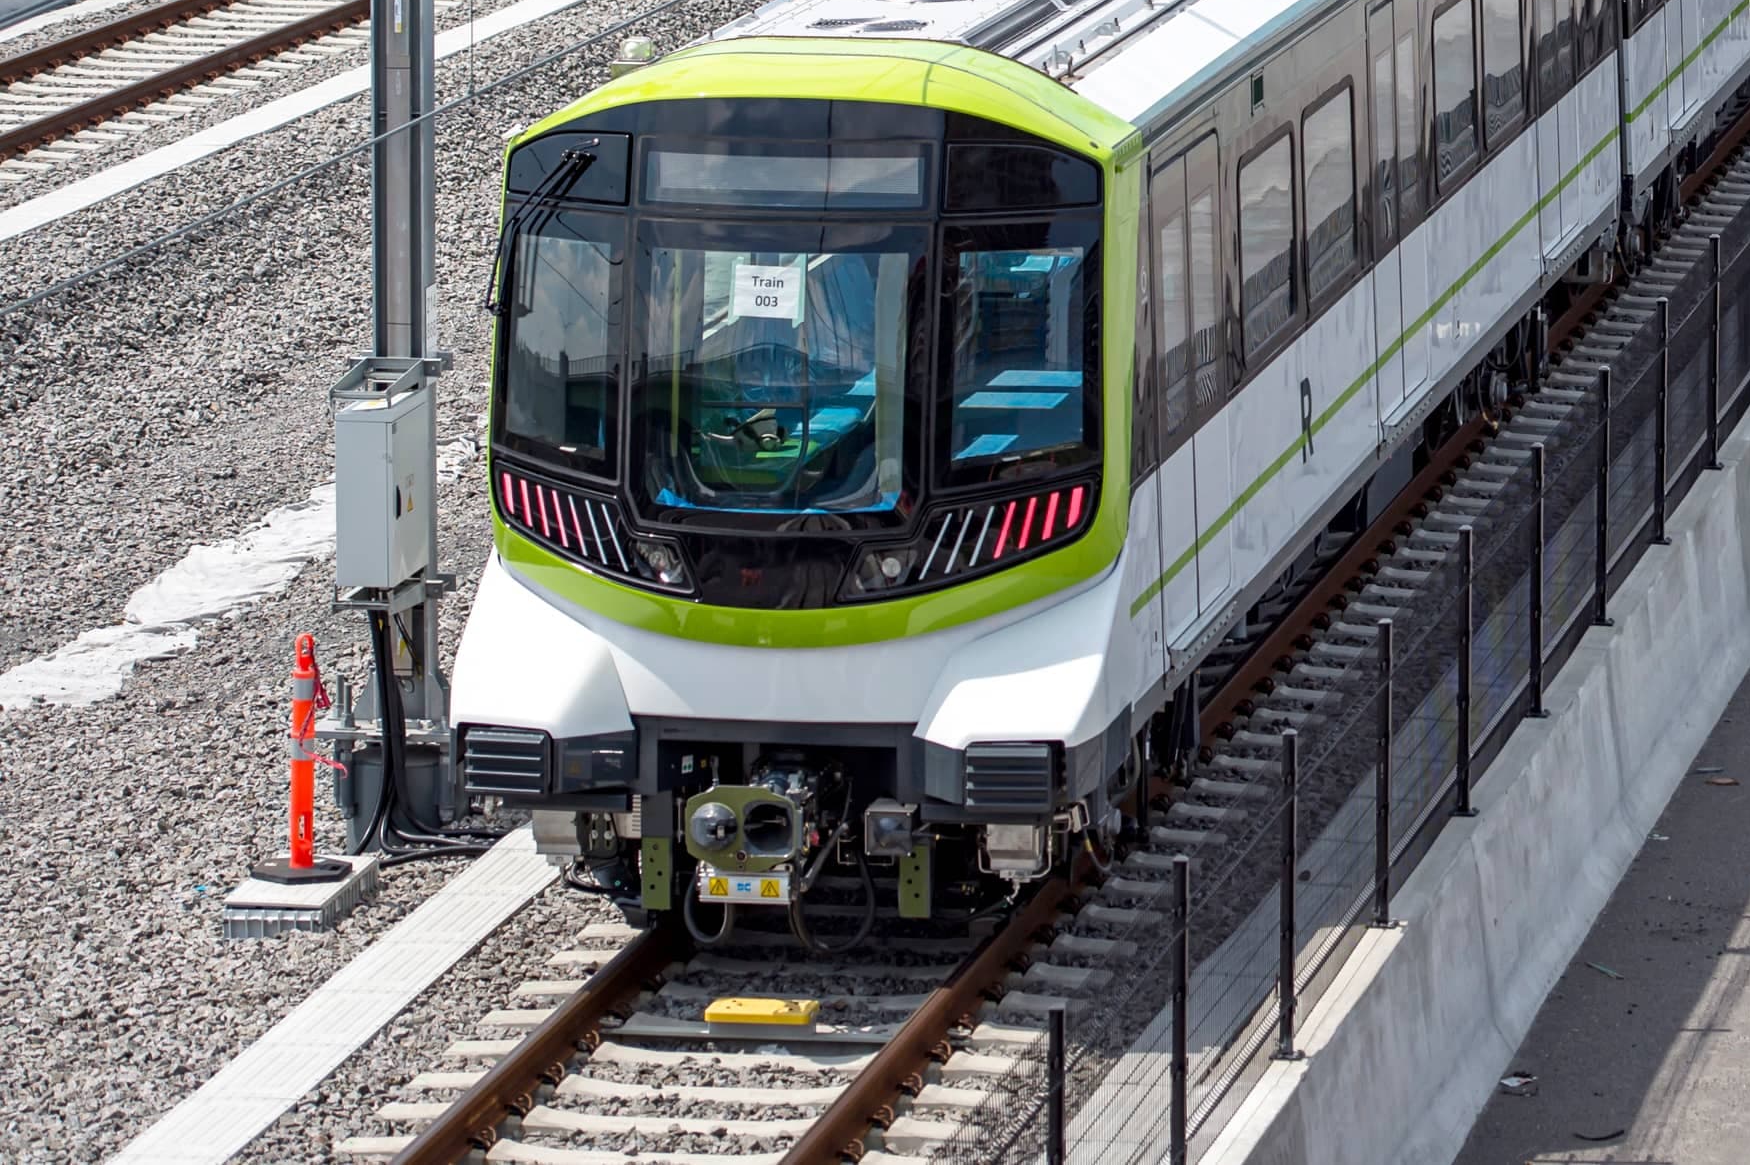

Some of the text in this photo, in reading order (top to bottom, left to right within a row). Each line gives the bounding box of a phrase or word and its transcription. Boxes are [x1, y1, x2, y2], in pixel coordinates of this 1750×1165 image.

[752, 275, 784, 289] Train
[755, 295, 778, 307] 003
[1300, 377, 1315, 465] R
